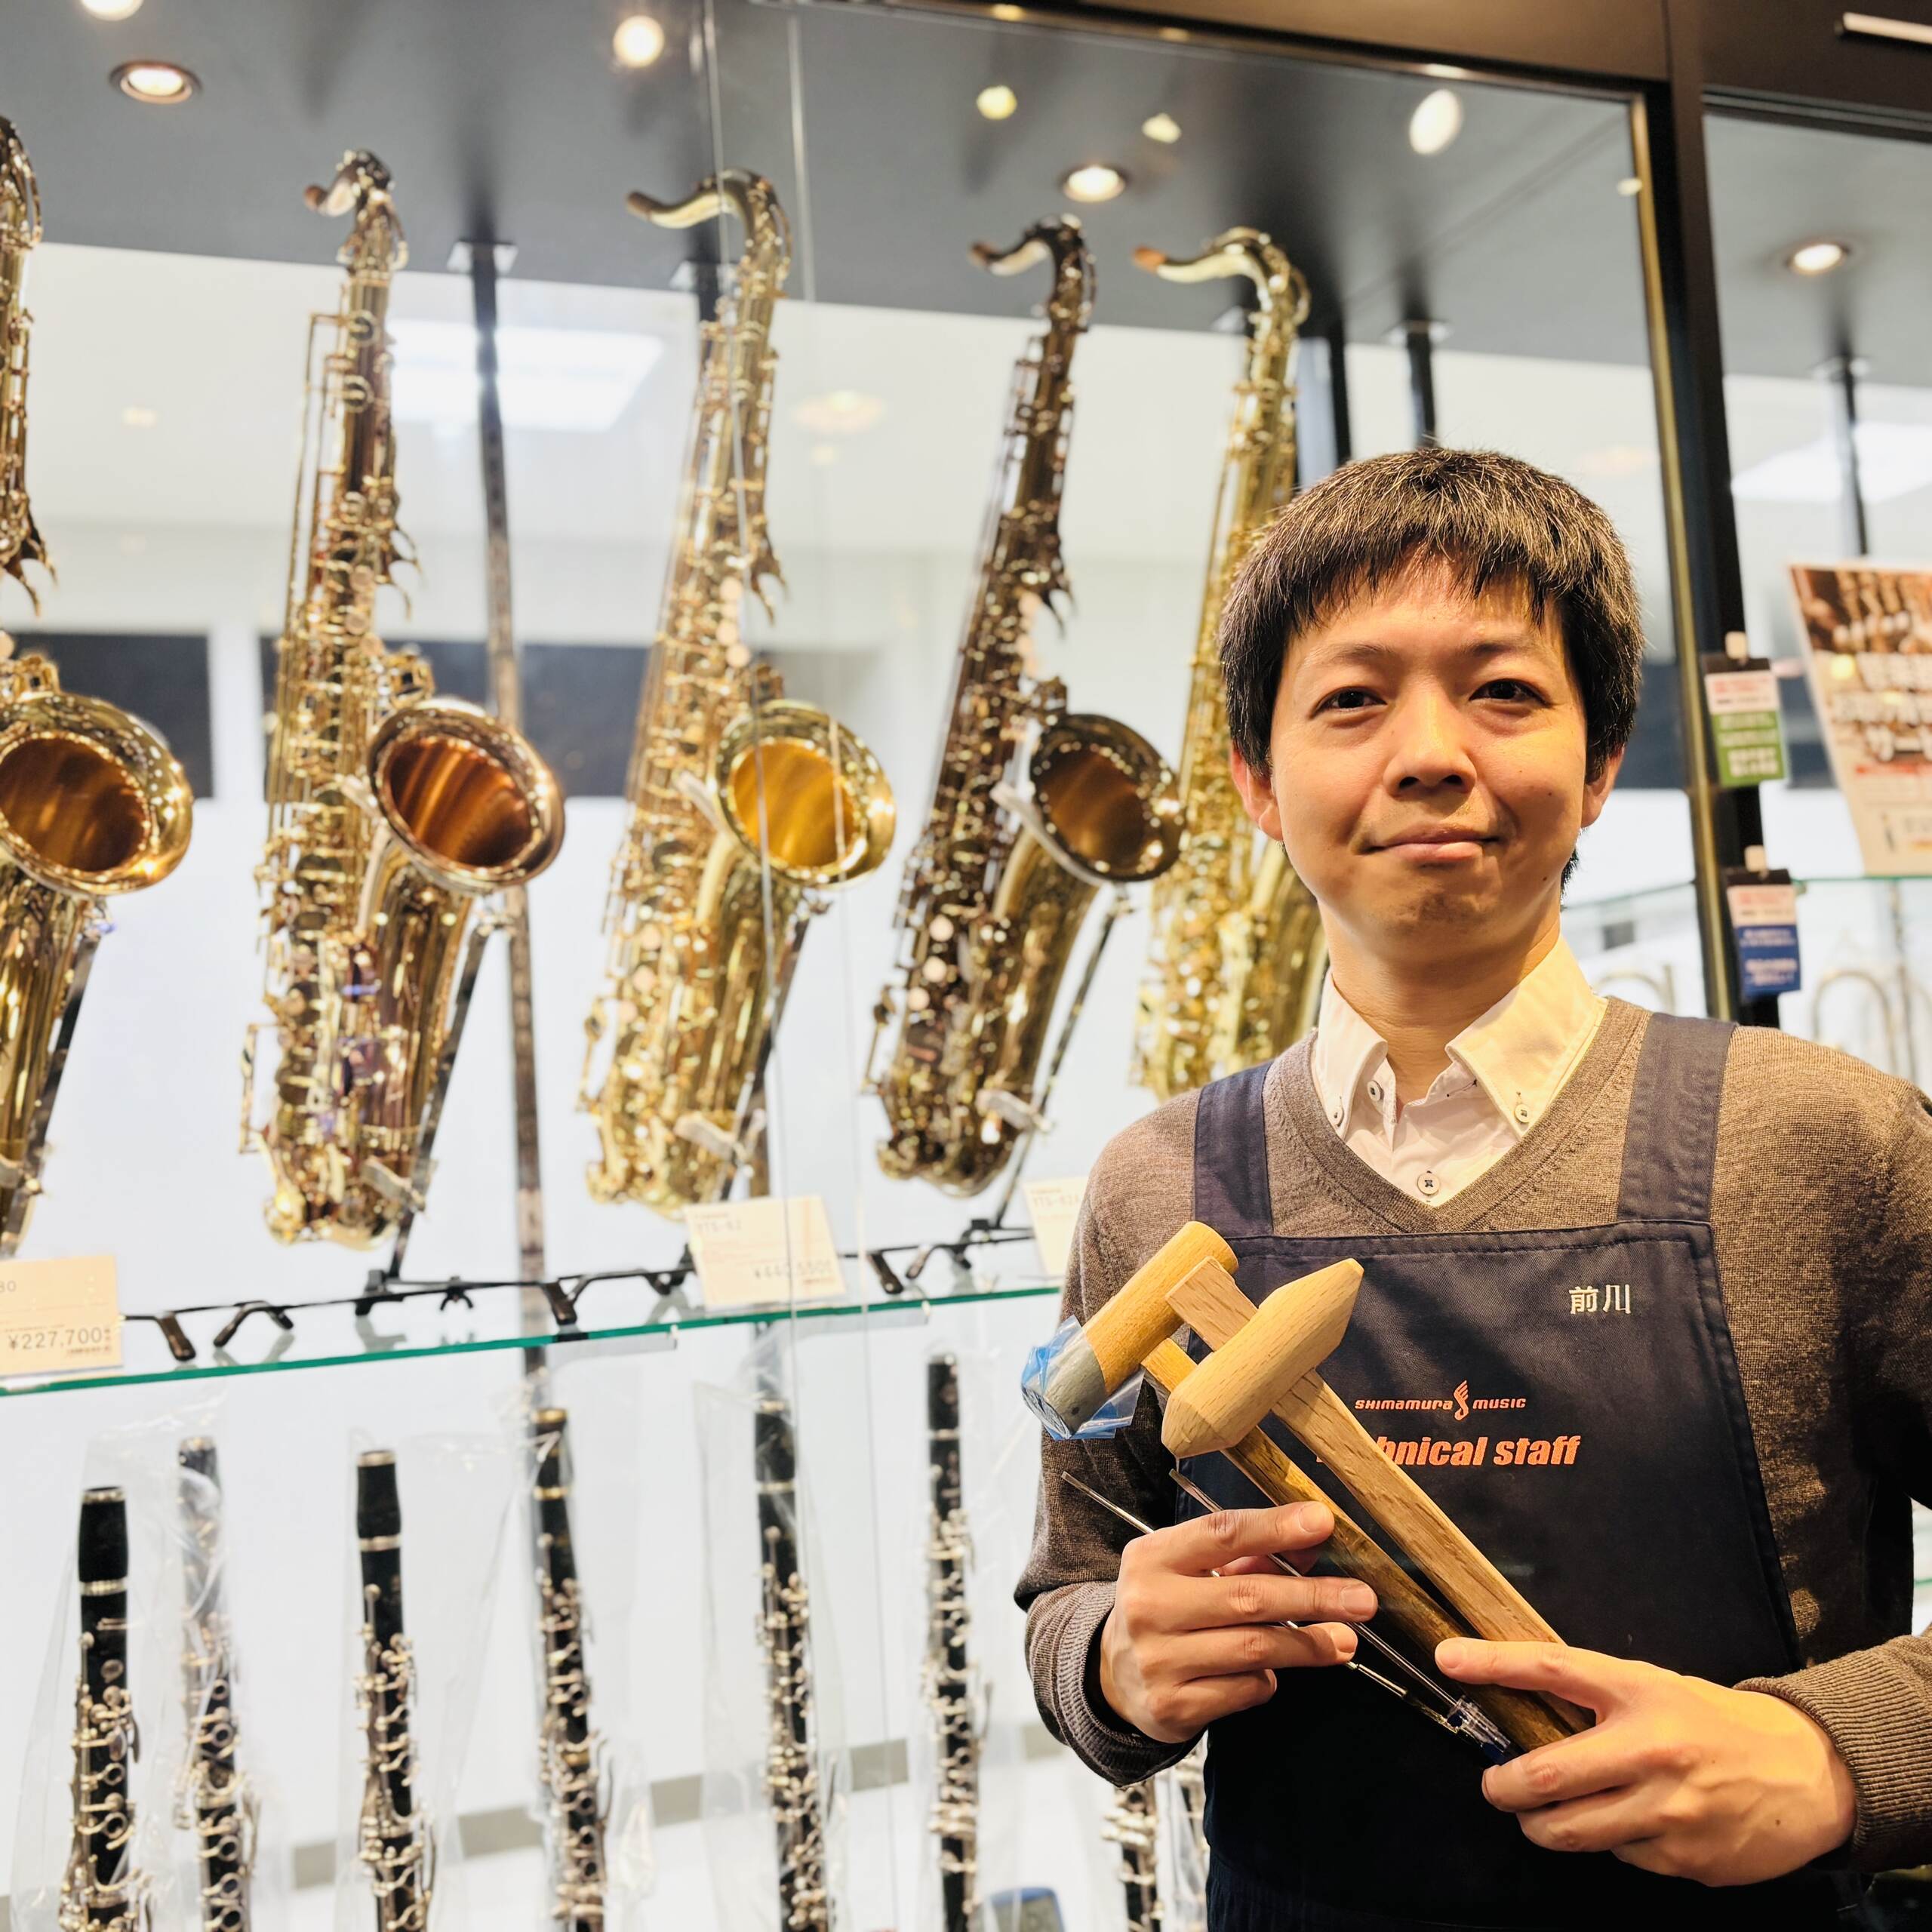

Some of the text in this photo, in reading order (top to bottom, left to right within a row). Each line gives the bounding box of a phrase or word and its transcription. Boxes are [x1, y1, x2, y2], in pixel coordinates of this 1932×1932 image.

[1568, 1284, 1632, 1315] 前川
[8, 1326, 103, 1351] ¥227,700
[1316, 1435, 1581, 1466] hnical staff
